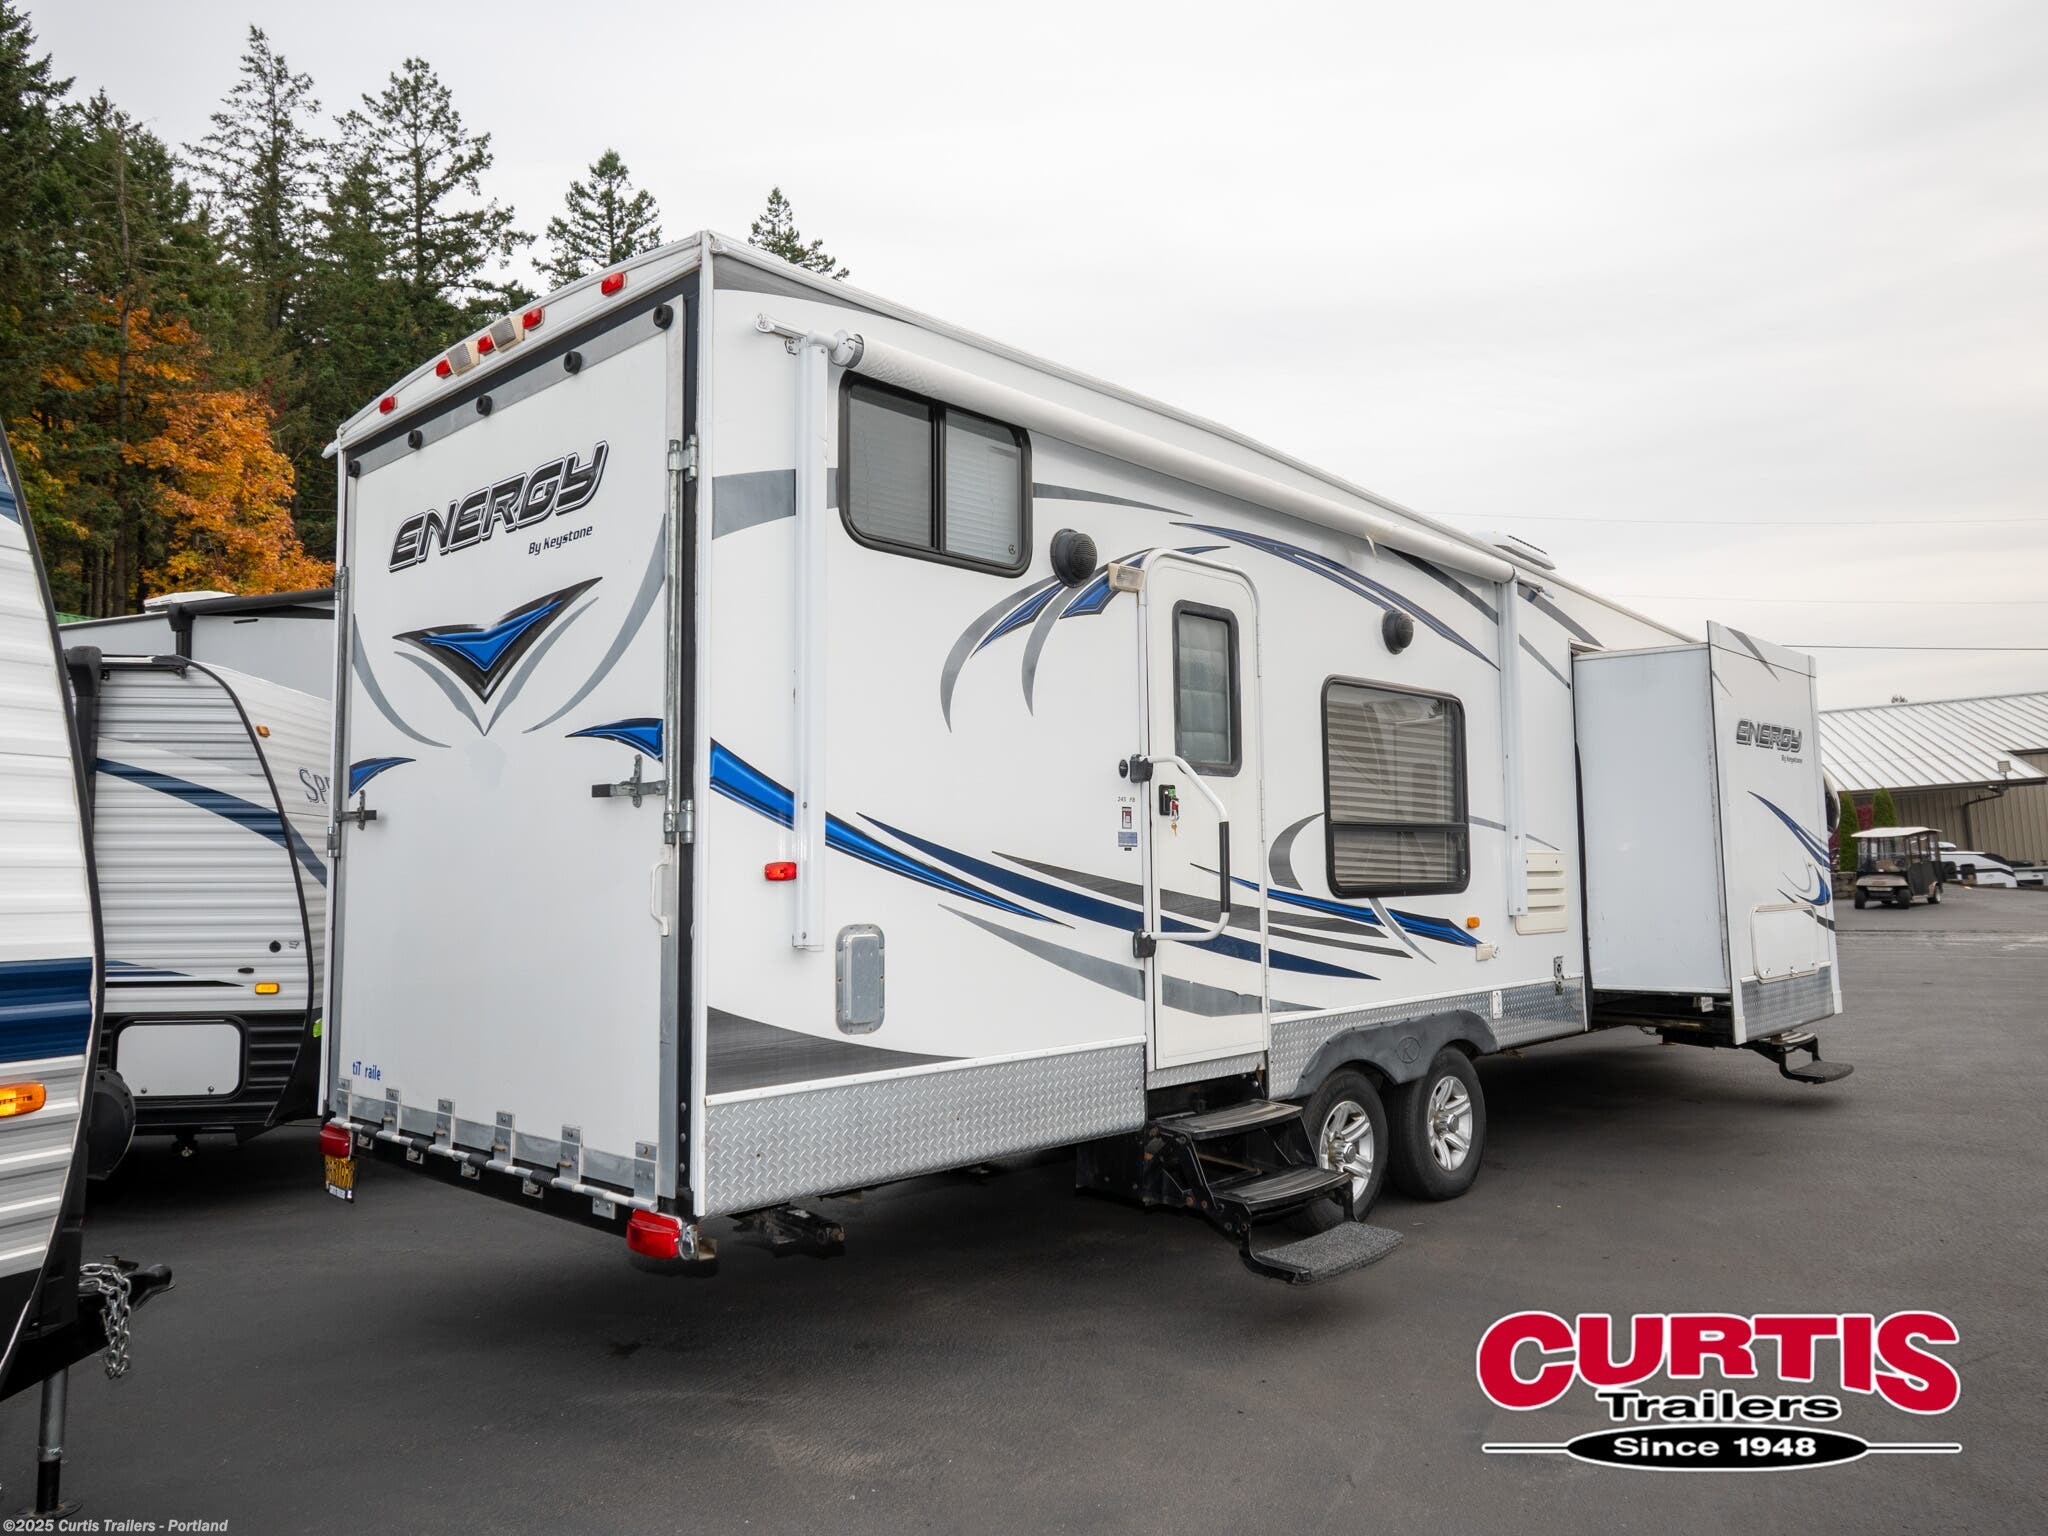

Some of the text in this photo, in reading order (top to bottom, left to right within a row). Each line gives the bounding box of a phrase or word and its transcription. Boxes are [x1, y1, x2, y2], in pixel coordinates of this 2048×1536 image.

[388, 440, 609, 573] ENERGY
[528, 525, 593, 556] By Keystone
[1735, 718, 1802, 753] ENERGY
